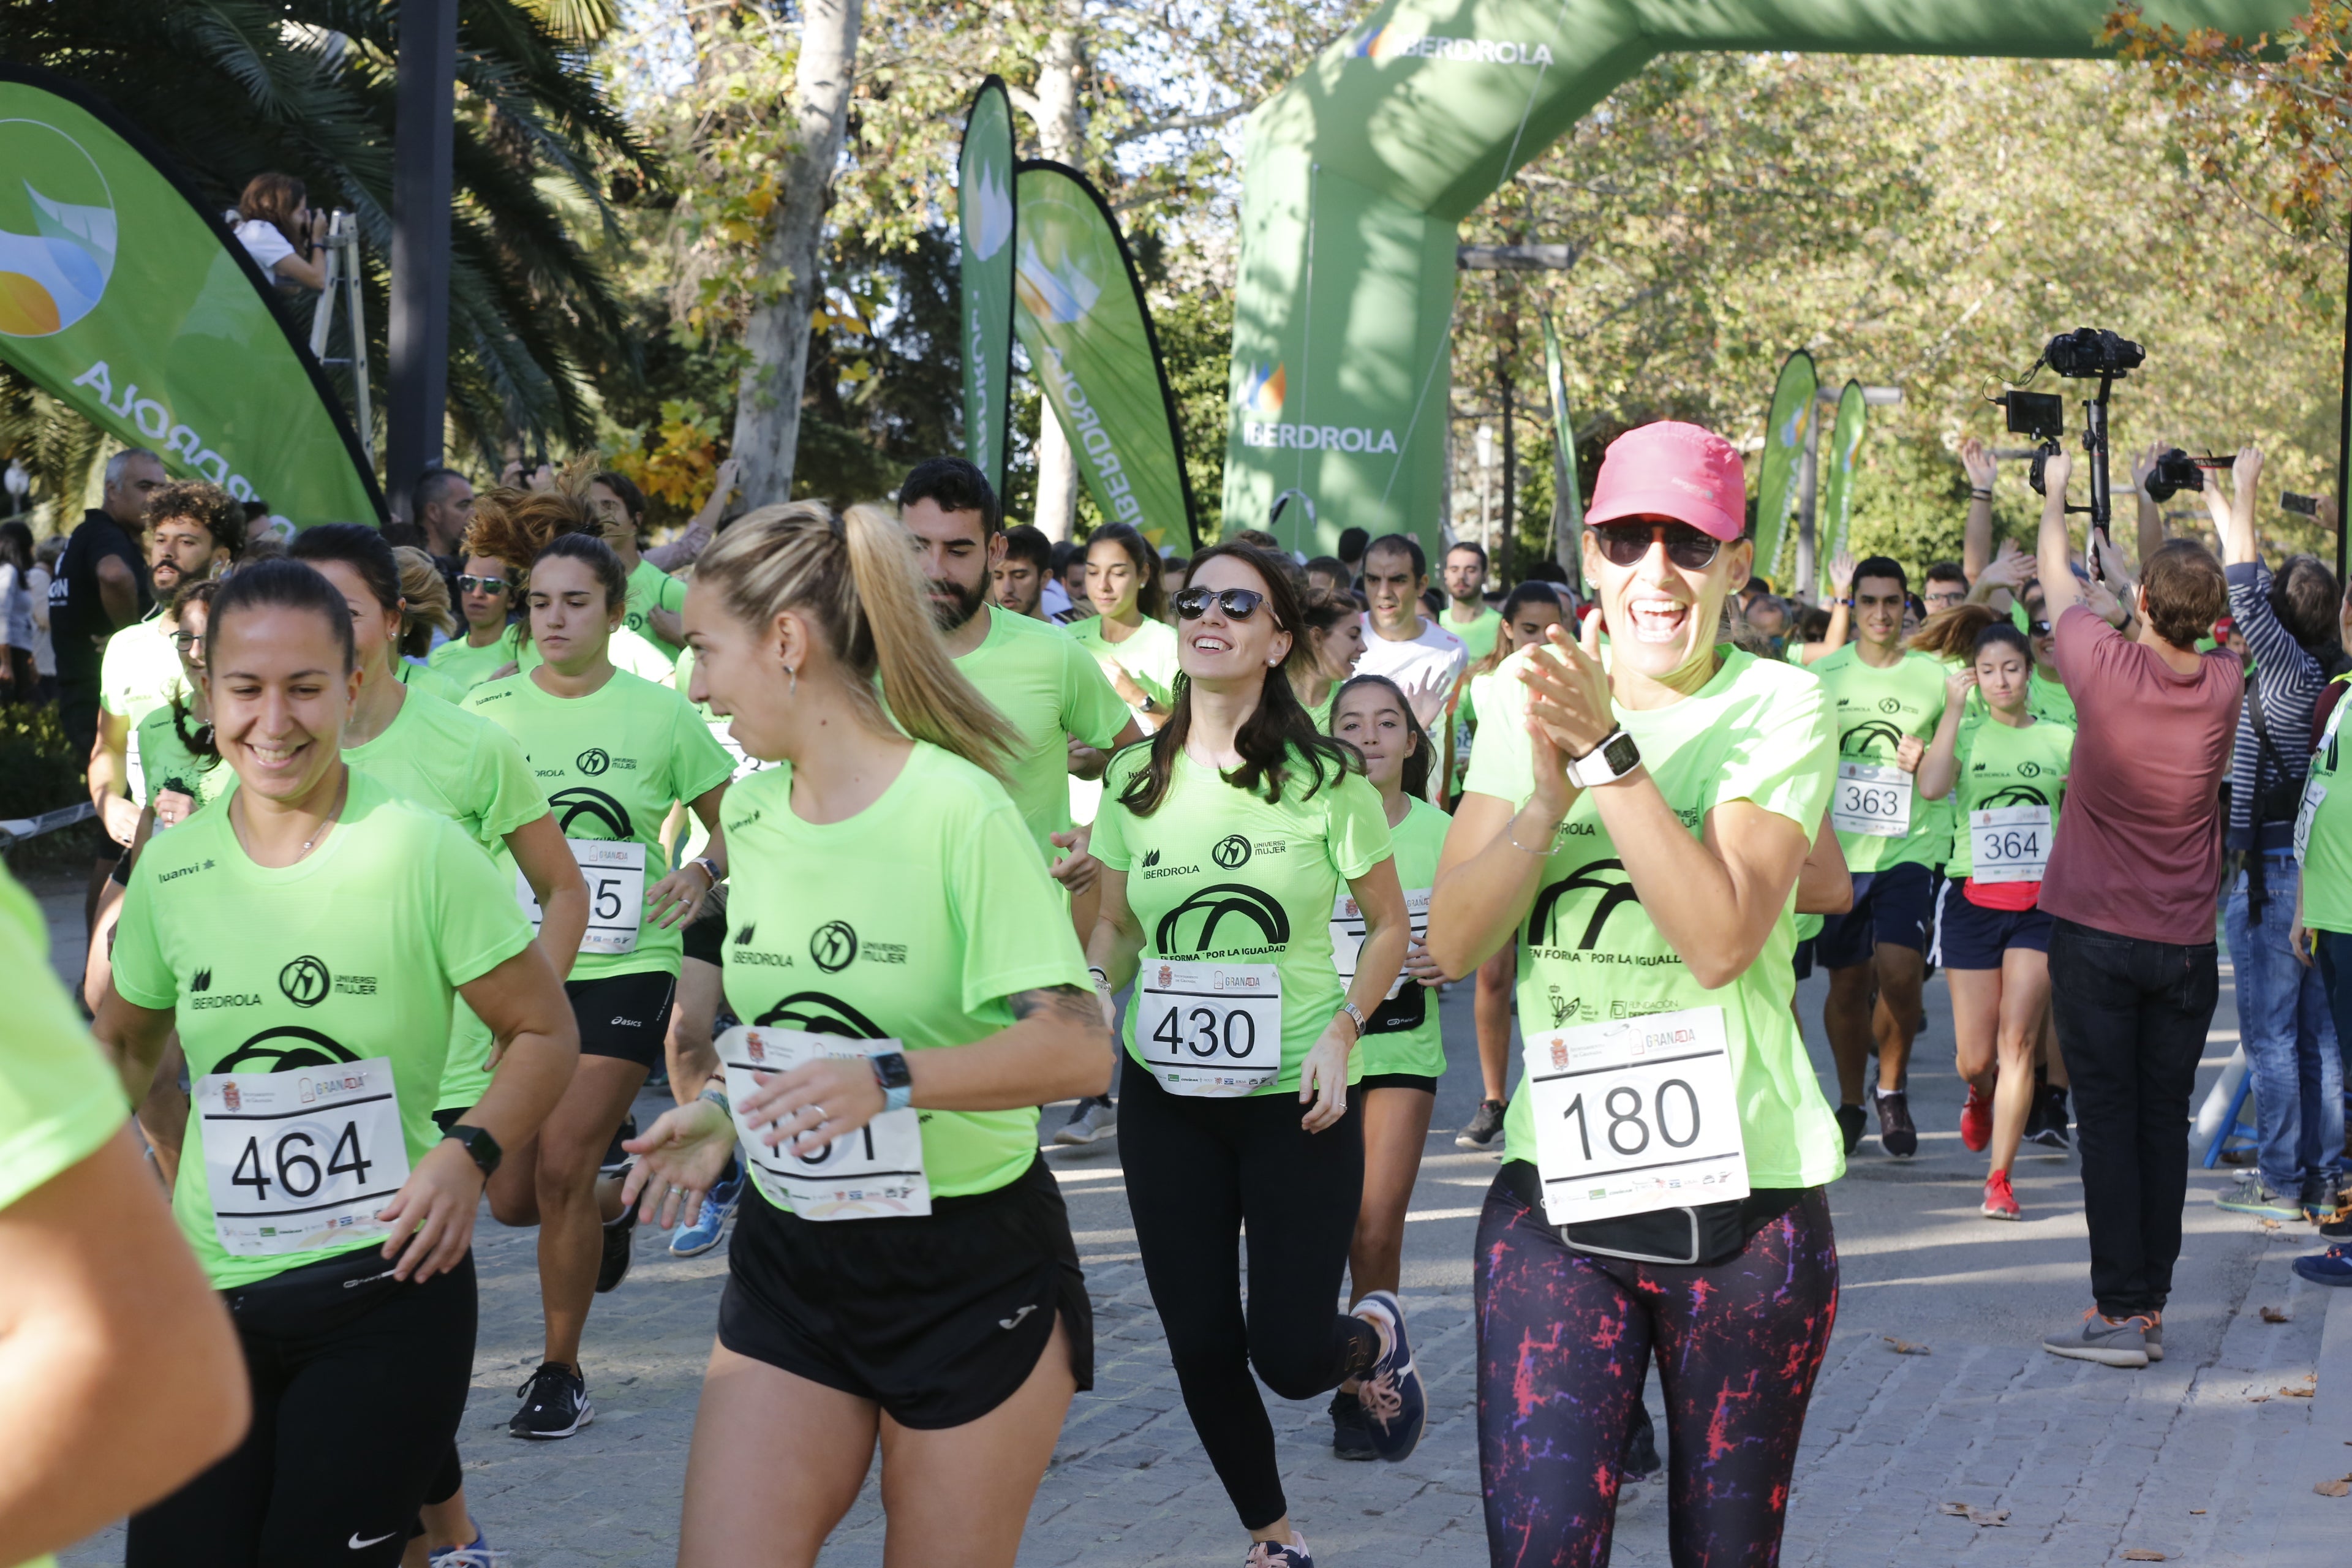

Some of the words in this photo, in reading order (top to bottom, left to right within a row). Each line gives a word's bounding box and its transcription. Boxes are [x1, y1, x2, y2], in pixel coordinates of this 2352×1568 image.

[1389, 33, 1554, 66] IBERDROLA
[1243, 421, 1398, 454] IBERDROLA
[476, 693, 502, 706] luanvi
[1845, 786, 1898, 816] 363
[1253, 840, 1286, 849] UNIVERSO
[1254, 845, 1286, 856] MUJER
[1984, 831, 2040, 860] 364
[158, 862, 200, 884] luanvi
[1143, 864, 1200, 880] IBERDROLA
[862, 941, 908, 953] UNIVERSO
[1206, 950, 1225, 959] POR
[1242, 945, 1286, 955] IGUALDAD
[734, 950, 794, 968] IBERDROLA
[861, 951, 907, 965] MUJER
[1591, 953, 1614, 963] POR
[1618, 954, 1632, 965] LA
[334, 974, 378, 985] UNIVERSO
[1225, 977, 1261, 987] GRANADA
[334, 982, 378, 995] MUJER
[190, 993, 263, 1011] IBERDROLA
[620, 1019, 642, 1027] asics
[1153, 1006, 1256, 1058] 430
[1646, 1028, 1696, 1048] GRANADA
[1563, 1078, 1701, 1161] 180
[231, 1120, 373, 1201] 464
